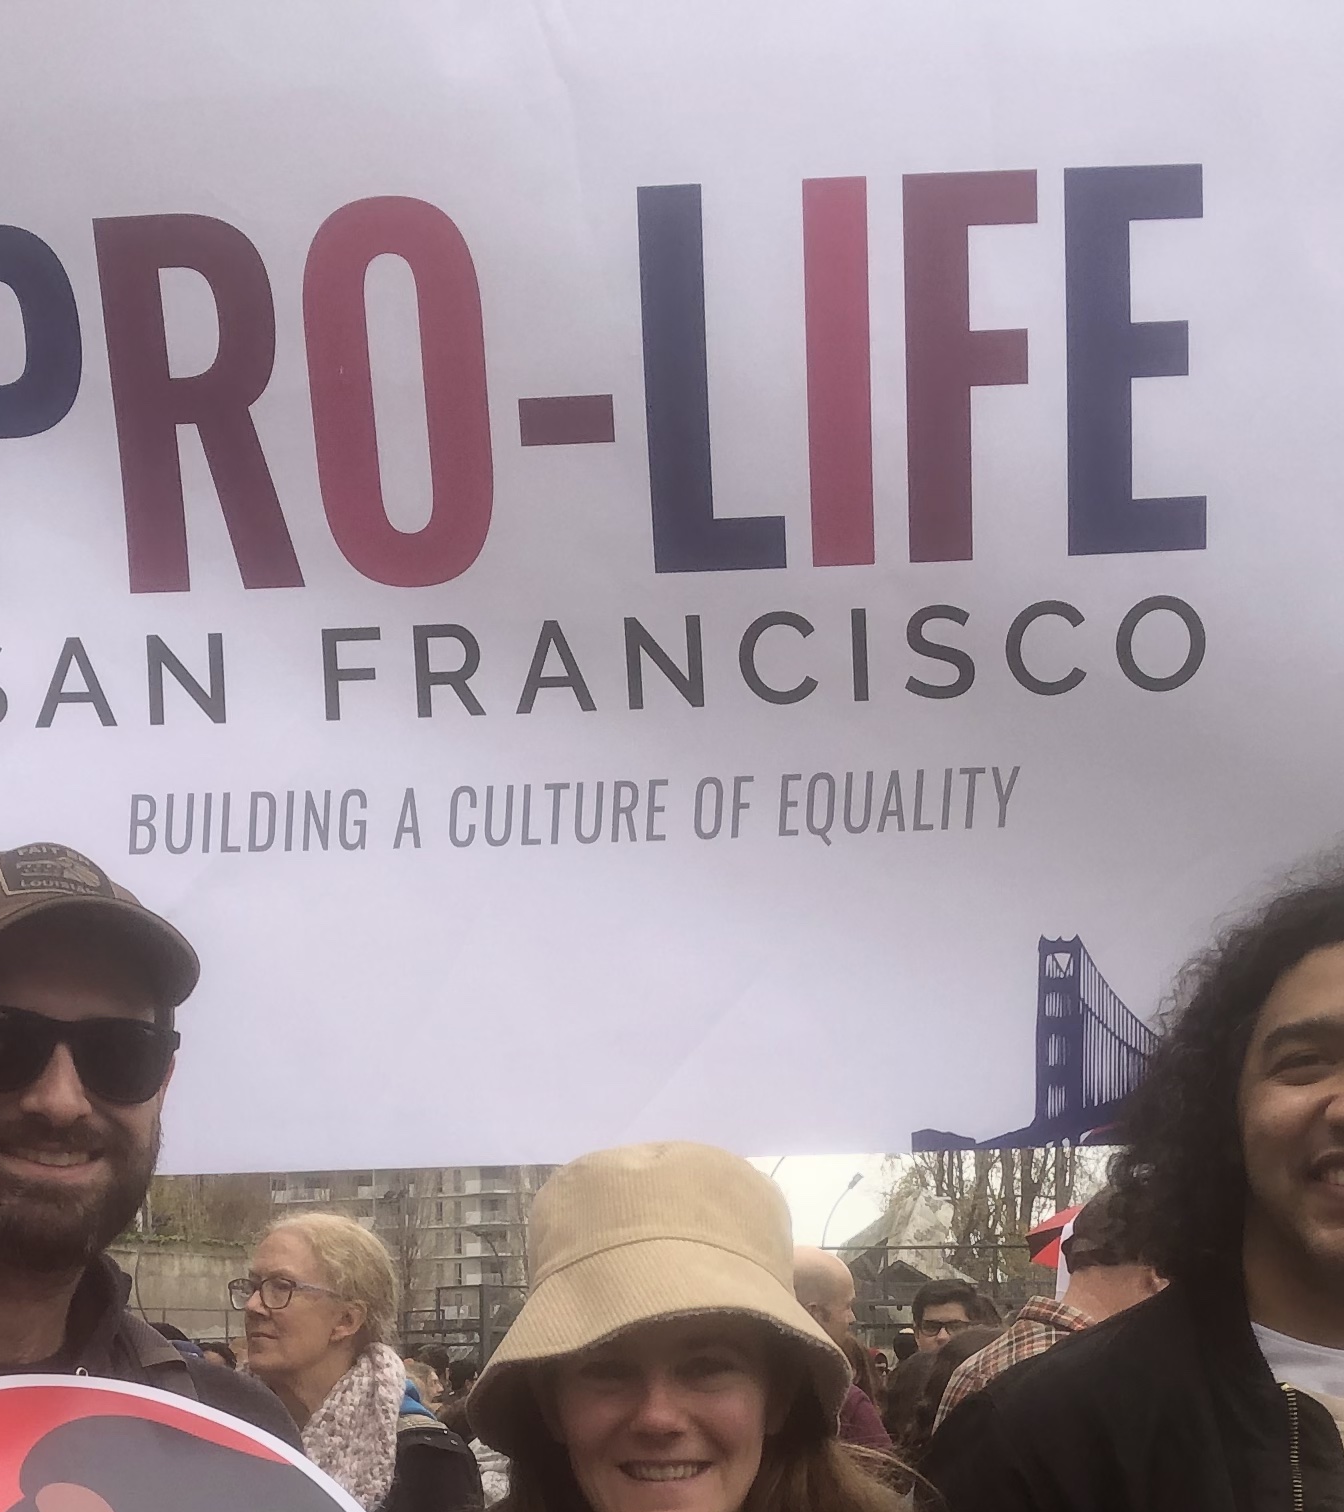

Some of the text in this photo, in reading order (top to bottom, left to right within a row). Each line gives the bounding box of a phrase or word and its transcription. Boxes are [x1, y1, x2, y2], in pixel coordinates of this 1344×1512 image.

[320, 594, 1208, 720] FRANCISCO
[128, 765, 1022, 857] BUILDING A CULTURE OF EQUALITY
